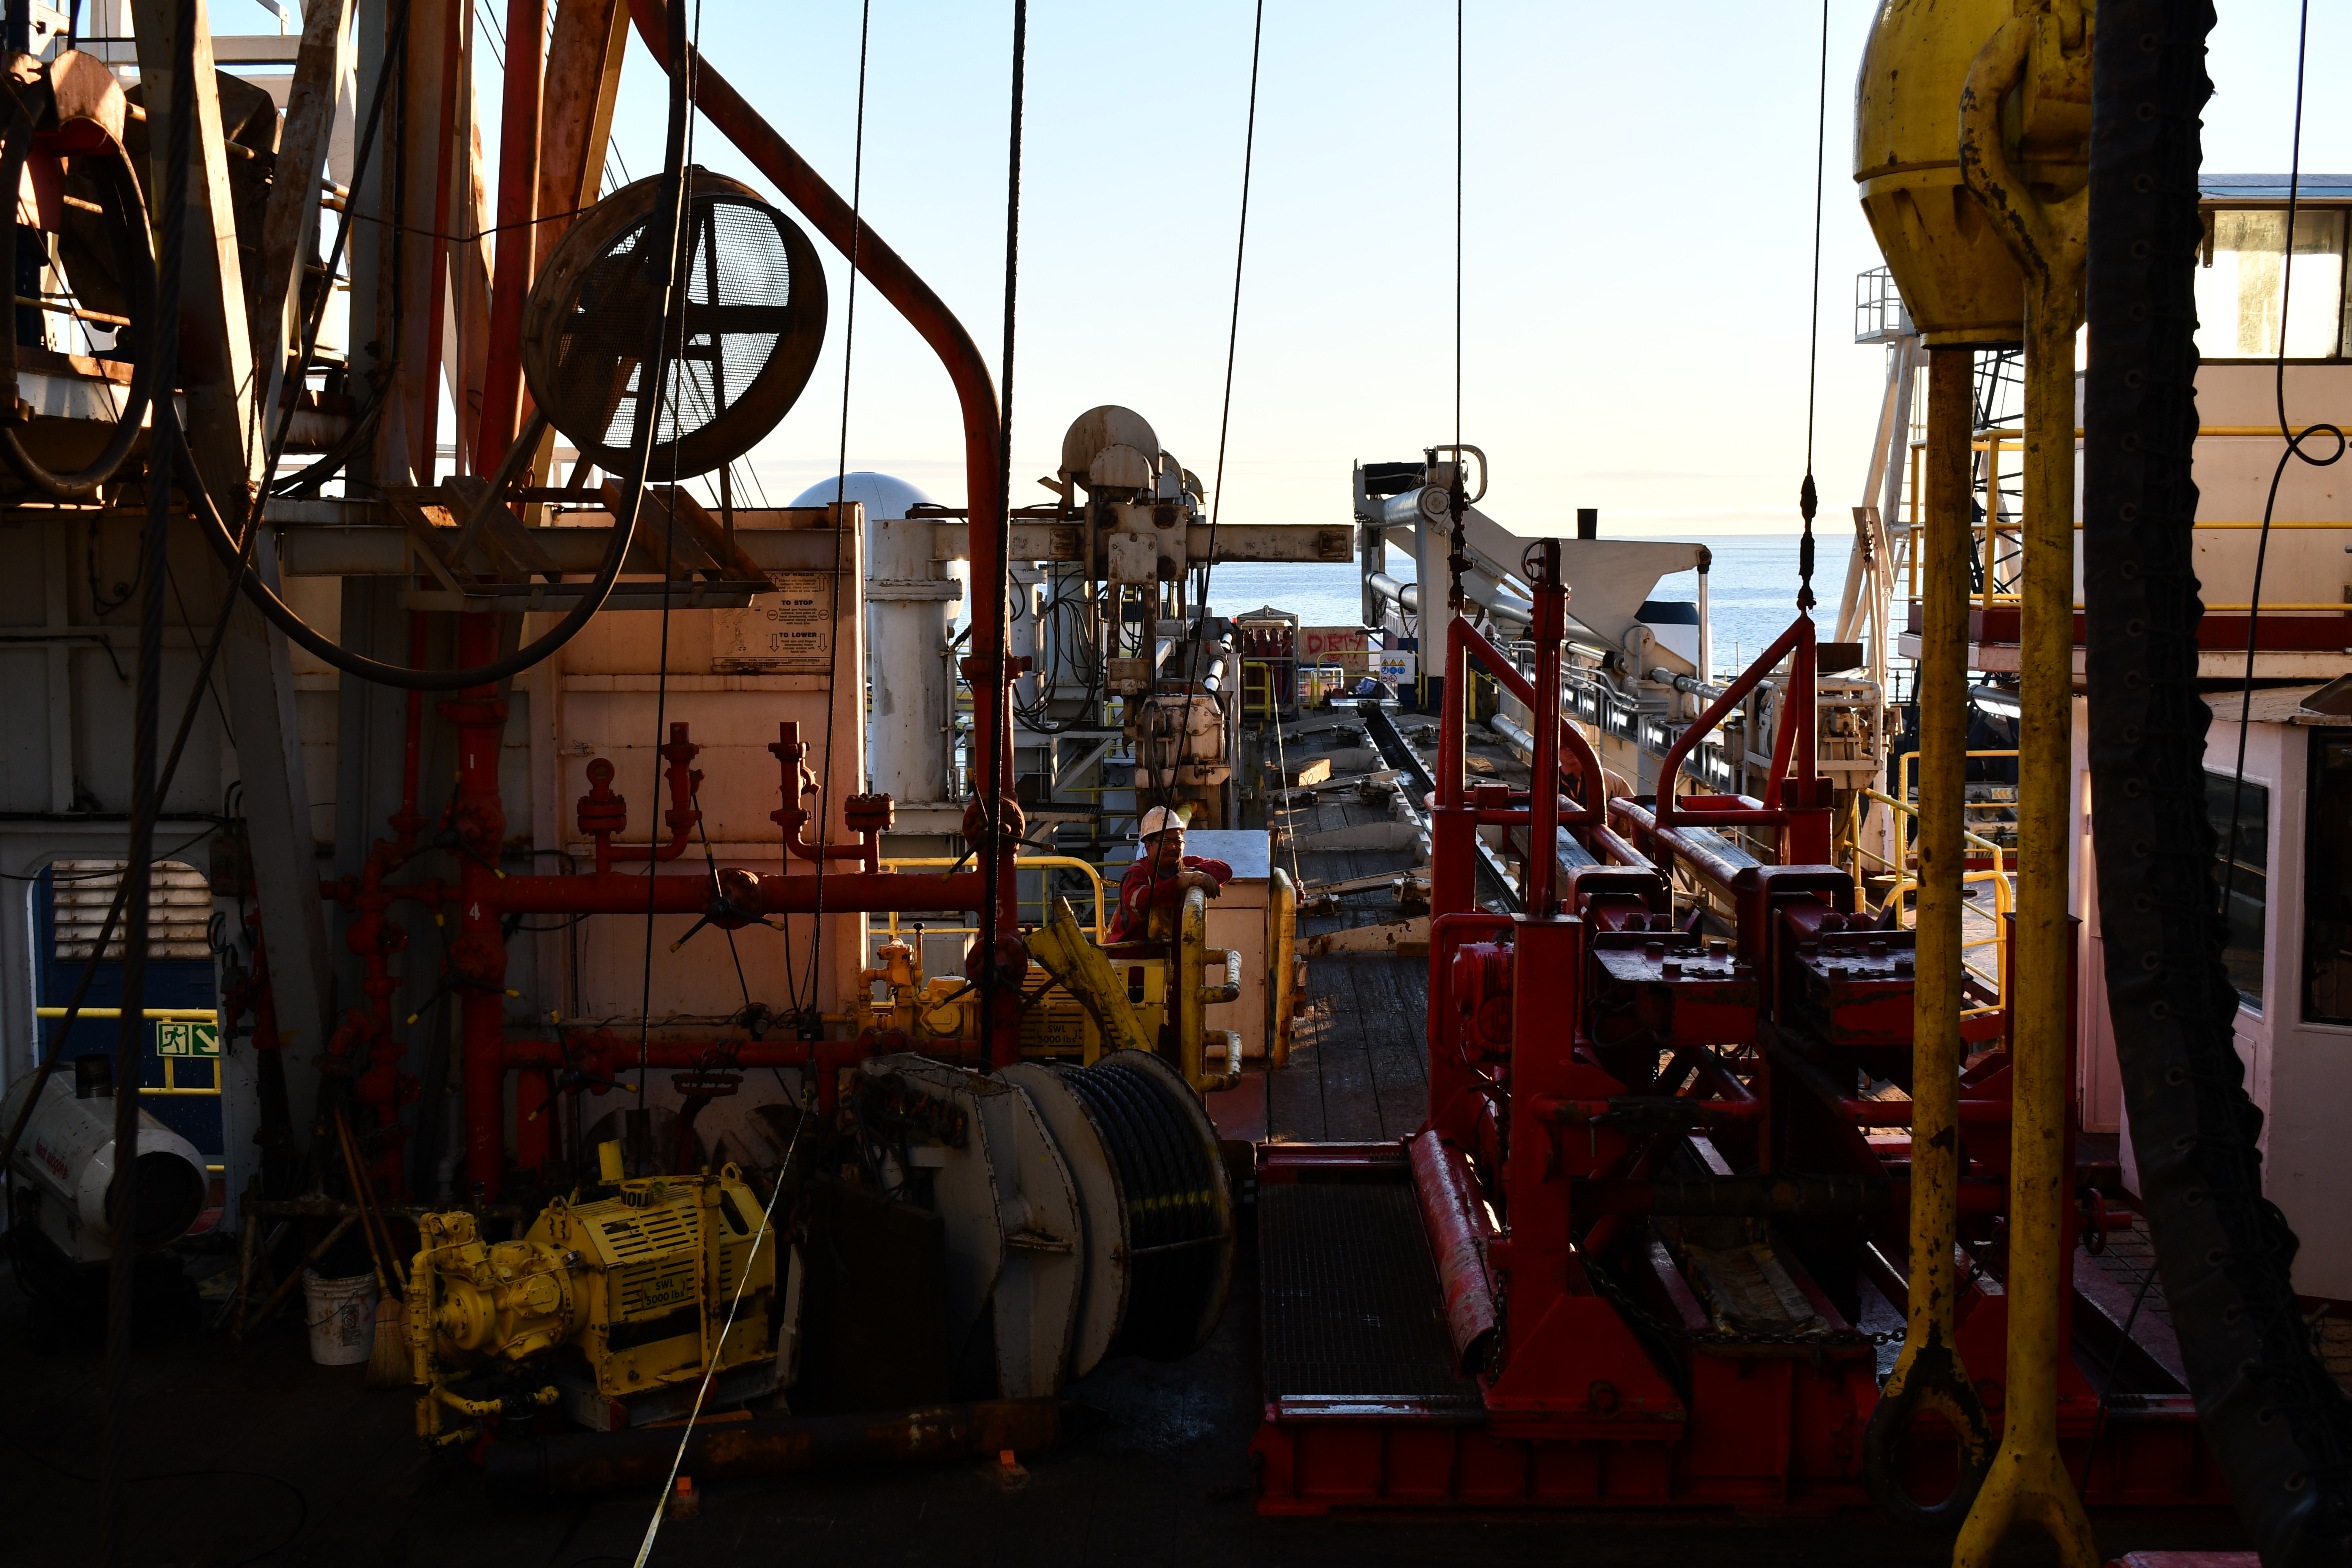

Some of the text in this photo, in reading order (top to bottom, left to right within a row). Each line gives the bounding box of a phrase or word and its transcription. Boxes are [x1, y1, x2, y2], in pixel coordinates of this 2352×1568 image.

[469, 902, 480, 921] 4
[35, 1137, 65, 1175] heat wagon
[656, 1278, 674, 1290] SWL
[646, 1290, 684, 1305] 5000 lbs
